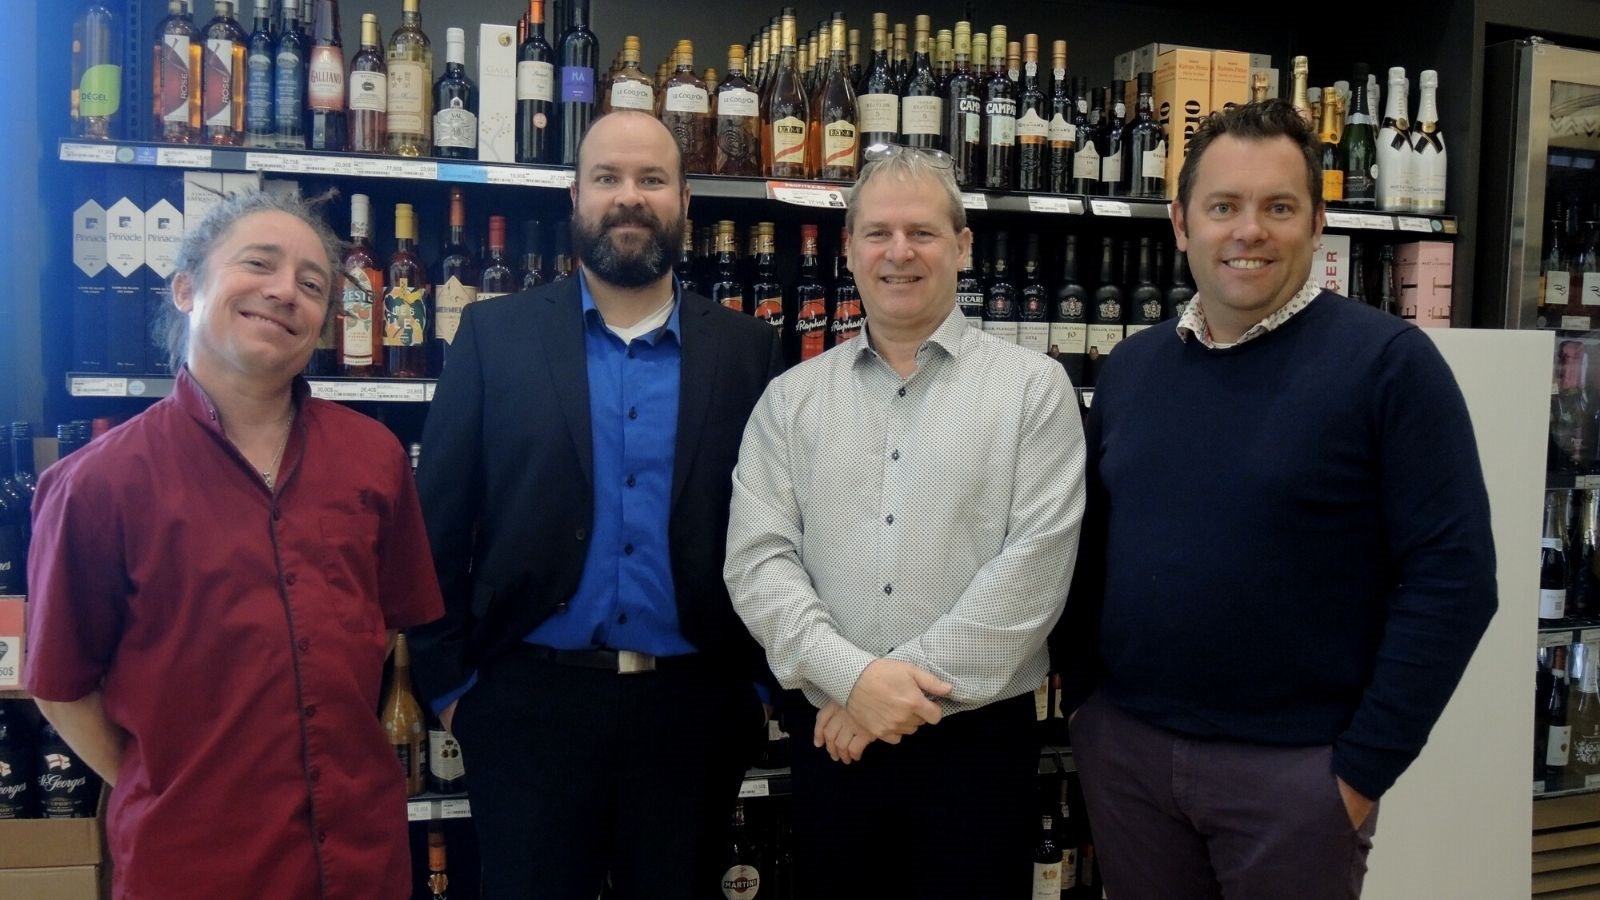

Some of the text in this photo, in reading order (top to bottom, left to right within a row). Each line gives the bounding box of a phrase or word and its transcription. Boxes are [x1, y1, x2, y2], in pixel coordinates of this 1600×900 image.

[311, 70, 342, 84] GALLIANO
[81, 92, 107, 101] DÉGEL
[109, 232, 142, 242] Pinnacle
[724, 879, 757, 889] MARTINI
